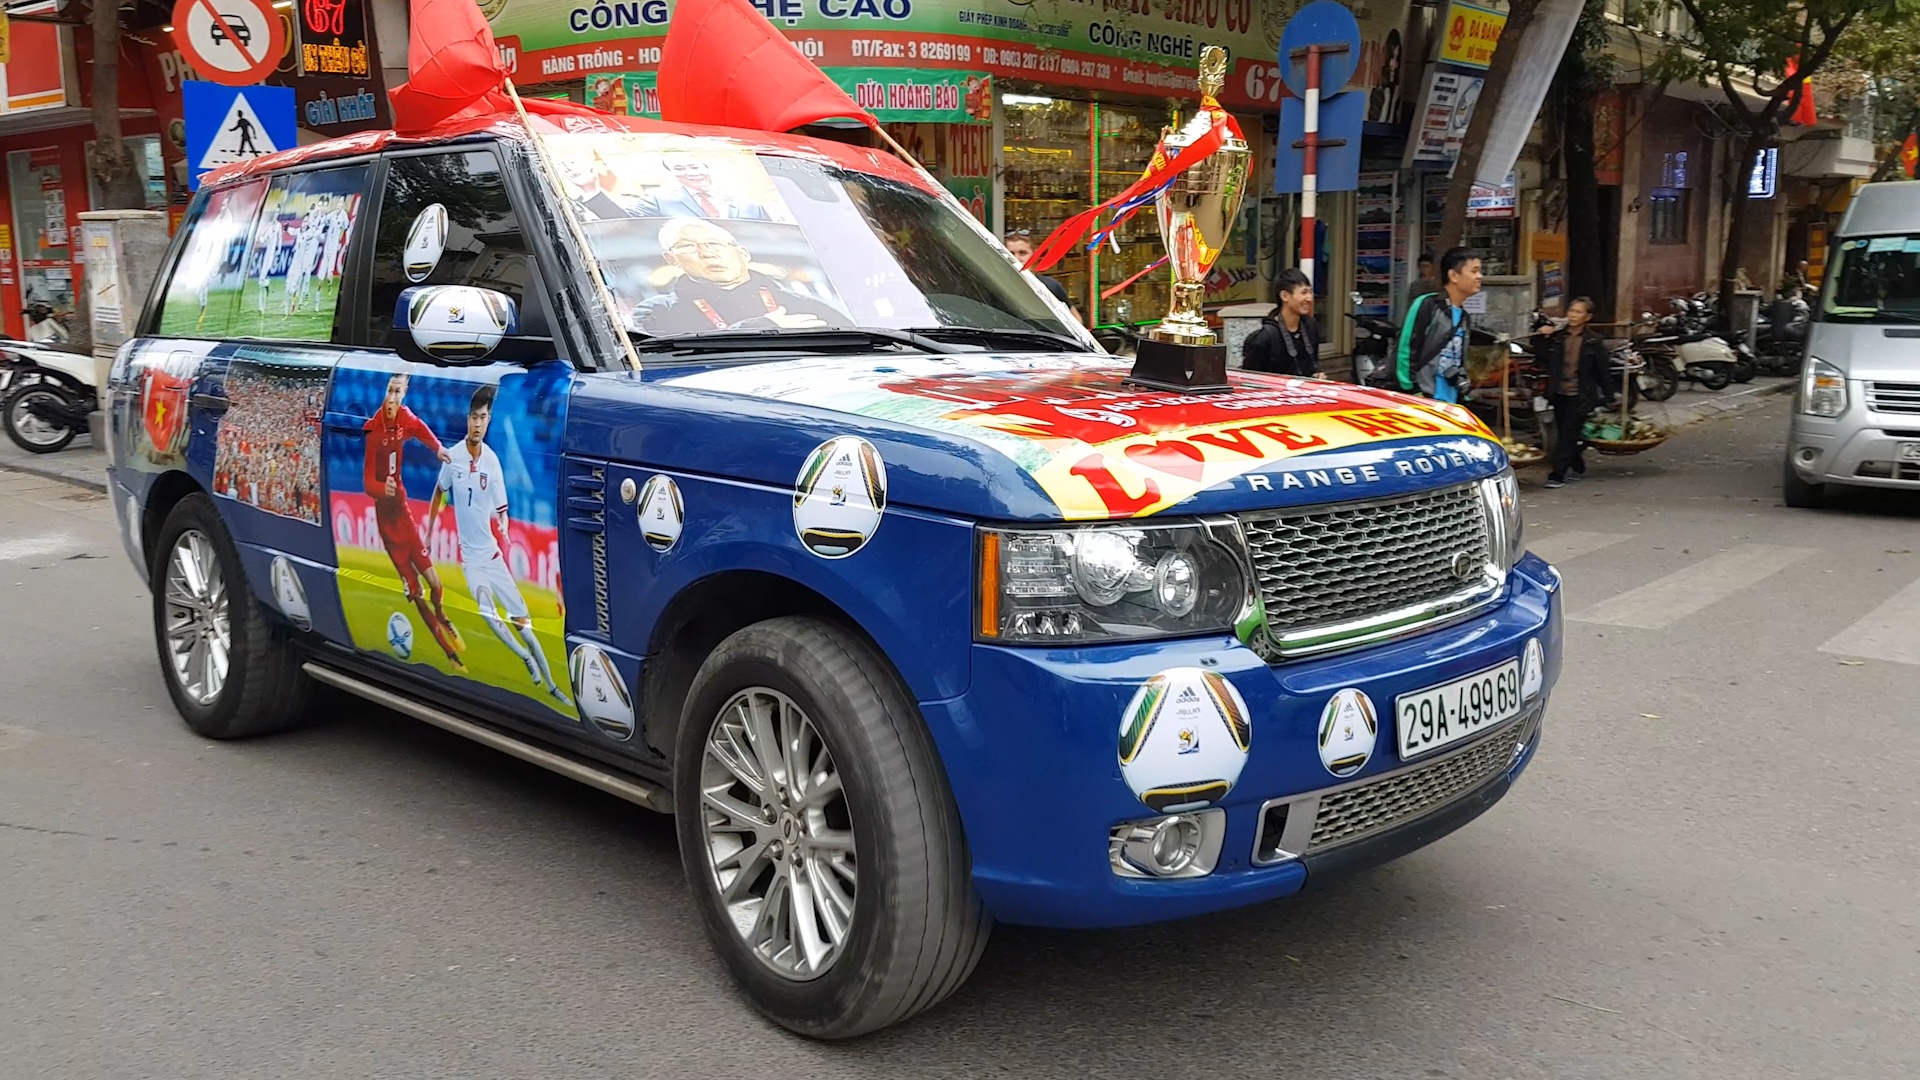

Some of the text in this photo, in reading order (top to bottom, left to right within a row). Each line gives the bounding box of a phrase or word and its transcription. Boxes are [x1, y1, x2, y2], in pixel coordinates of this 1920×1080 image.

[304, 0, 346, 35] 67
[570, 0, 669, 33] CÔNG
[819, 0, 912, 20] CAO
[542, 54, 575, 75] HÀNG
[577, 46, 623, 71] TRỐNG
[851, 39, 905, 58] ĐT/Fax:
[908, 41, 917, 58] 3
[920, 41, 971, 62] 8269199
[1089, 19, 1142, 50] CÔNG
[1147, 34, 1194, 65] NGHỆ
[888, 79, 932, 109] HOÀNG
[1245, 64, 1283, 102] 67
[1330, 410, 1442, 438] AFC
[1247, 451, 1479, 493] RANGE ROVER
[1403, 668, 1518, 750] 29A-499.69
